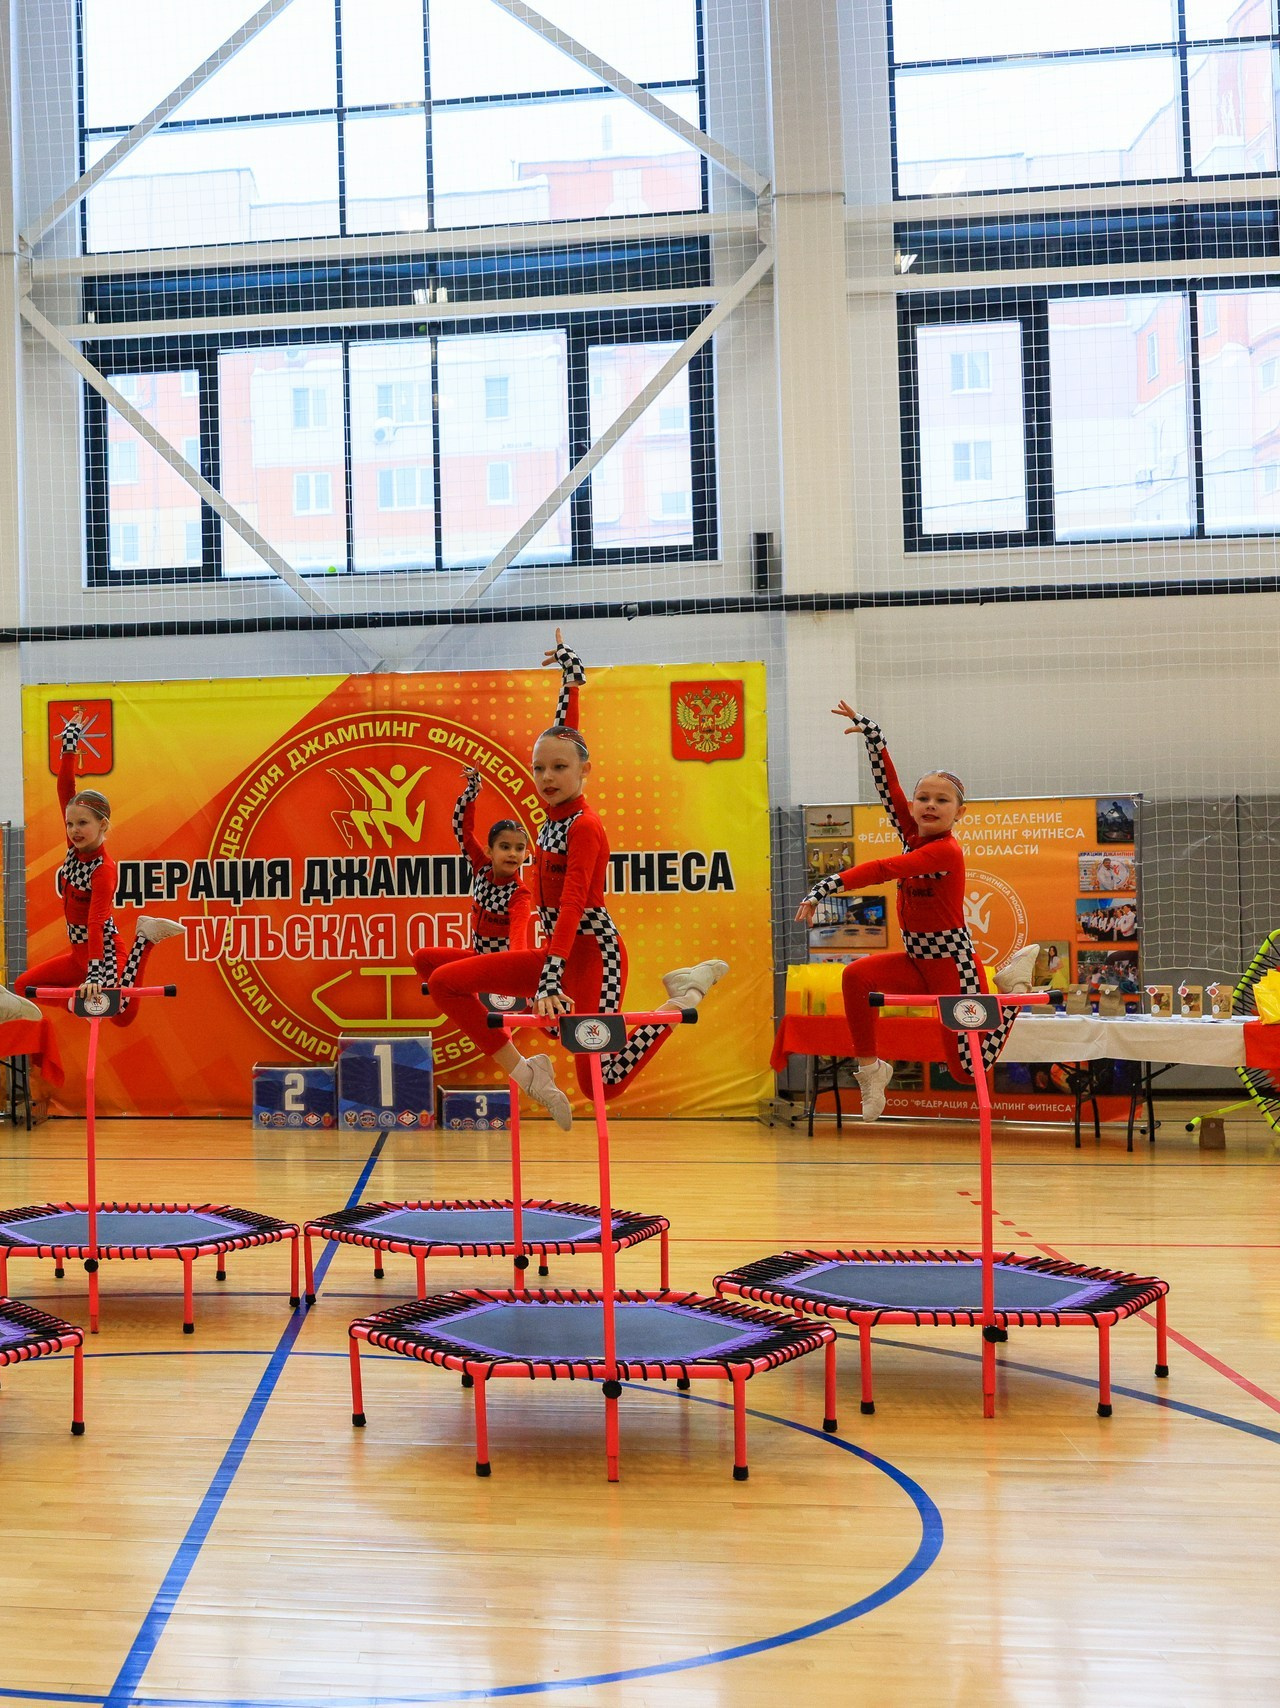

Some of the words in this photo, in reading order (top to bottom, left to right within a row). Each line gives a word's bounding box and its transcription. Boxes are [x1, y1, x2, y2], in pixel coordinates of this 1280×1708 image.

[219, 763, 285, 859] ДЕРАЦИЯ
[286, 721, 420, 771] ДЖАМПИНГ
[428, 728, 524, 795] ФИТНЕСА
[858, 832, 900, 844] ФЕДЕР
[953, 829, 1019, 841] ЖАМПИНГ
[1021, 827, 1085, 840] ФИТНЕСА
[984, 812, 1063, 826] ОТДЕЛЕНИЕ
[975, 844, 1039, 857] ОБЛАСТИ
[56, 857, 291, 907] ДЕРАЦИЯ
[301, 853, 532, 905] ДЖАМПИ
[604, 850, 736, 895] ТНЕСА
[179, 914, 396, 962] ТУЛЬСКАЯ
[223, 935, 273, 1016] SIAN
[270, 1016, 339, 1062] JUMPI
[284, 1073, 305, 1111] 2
[373, 1044, 394, 1107] 1
[475, 1095, 488, 1117] 3
[886, 1098, 909, 1107] СОО
